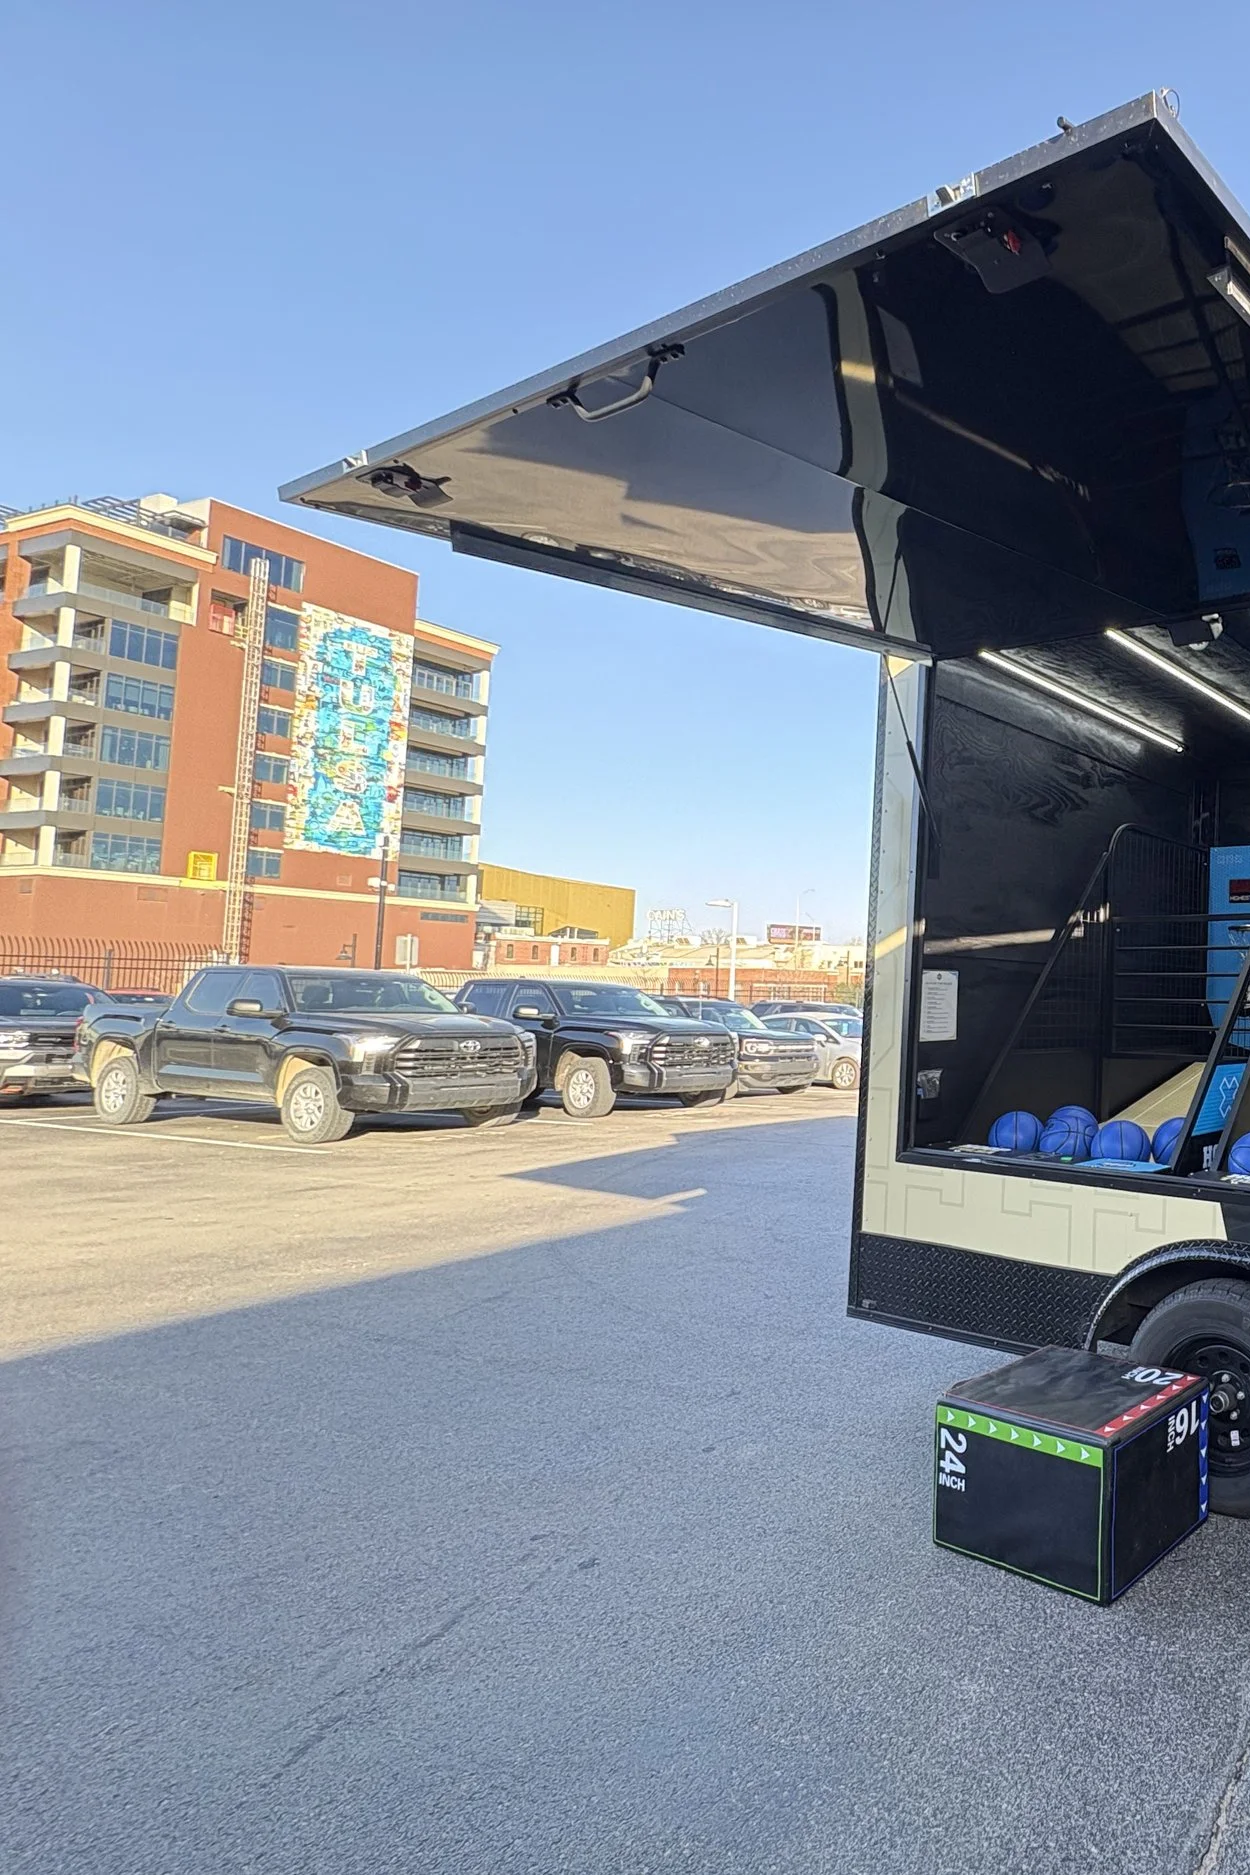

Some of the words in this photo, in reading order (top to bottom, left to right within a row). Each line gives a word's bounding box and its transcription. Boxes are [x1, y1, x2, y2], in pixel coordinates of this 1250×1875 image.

[326, 640, 378, 836] TULSA
[1134, 1368, 1184, 1386] 20
[1166, 1414, 1176, 1453] INCH
[1175, 1400, 1199, 1445] 16
[939, 1427, 967, 1474] 24
[938, 1472, 966, 1492] INCH
